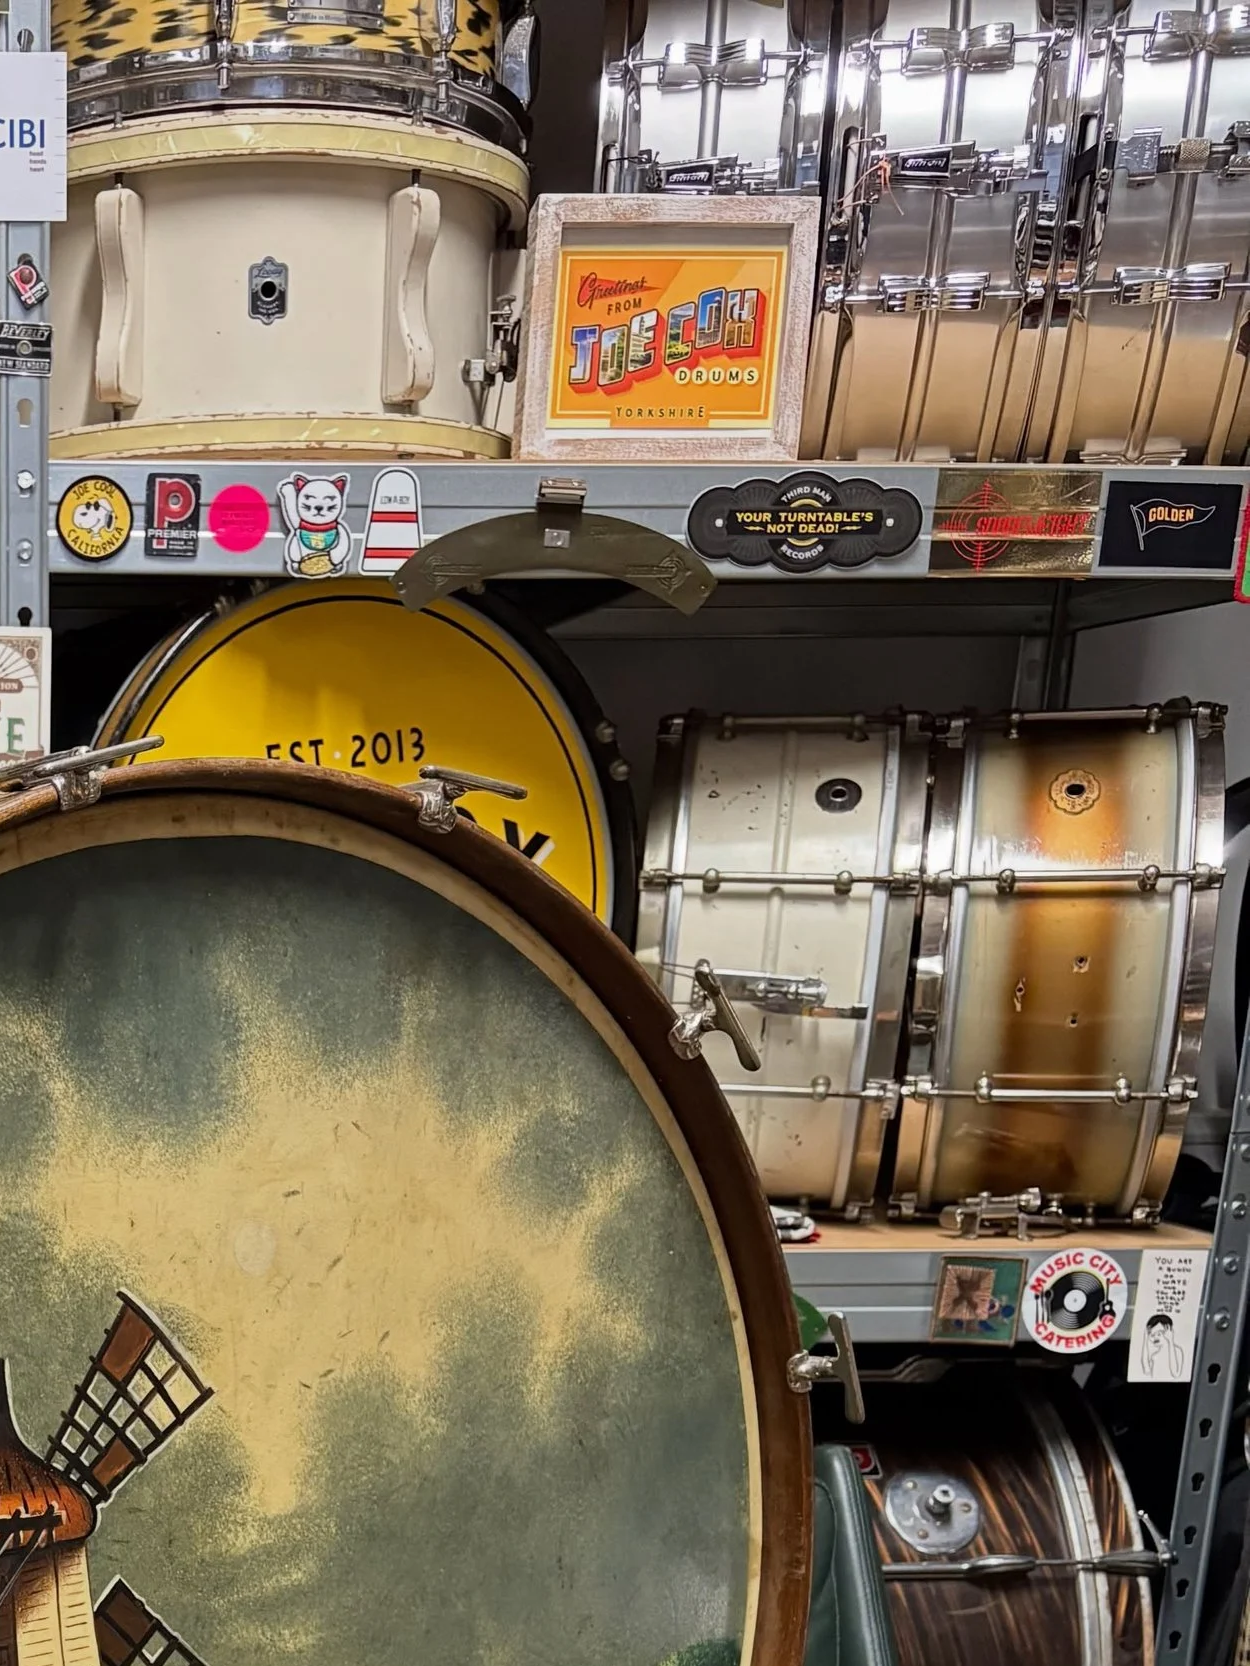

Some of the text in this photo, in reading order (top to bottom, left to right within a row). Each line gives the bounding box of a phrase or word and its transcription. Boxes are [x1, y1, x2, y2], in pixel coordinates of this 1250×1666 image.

[607, 298, 642, 315] FROM
[569, 287, 764, 388] JOE COX
[678, 370, 755, 382] DRUMS
[616, 407, 705, 418] YORKSHIRE
[74, 480, 115, 500] JOE COOL
[781, 486, 832, 503] THIRD MAN
[736, 512, 874, 523] YOUR TURNTABLE'S
[1149, 507, 1194, 522] GOLDEN
[147, 528, 198, 540] PREMIER
[766, 524, 839, 534] NOT DEAD!
[67, 527, 124, 557] CALIFORNIA
[780, 545, 824, 560] RECORDS
[351, 728, 425, 768] 2013
[1155, 1256, 1173, 1265] YOU
[1031, 1252, 1122, 1293] MUSIC CITY
[1035, 1314, 1115, 1348] CATERING
